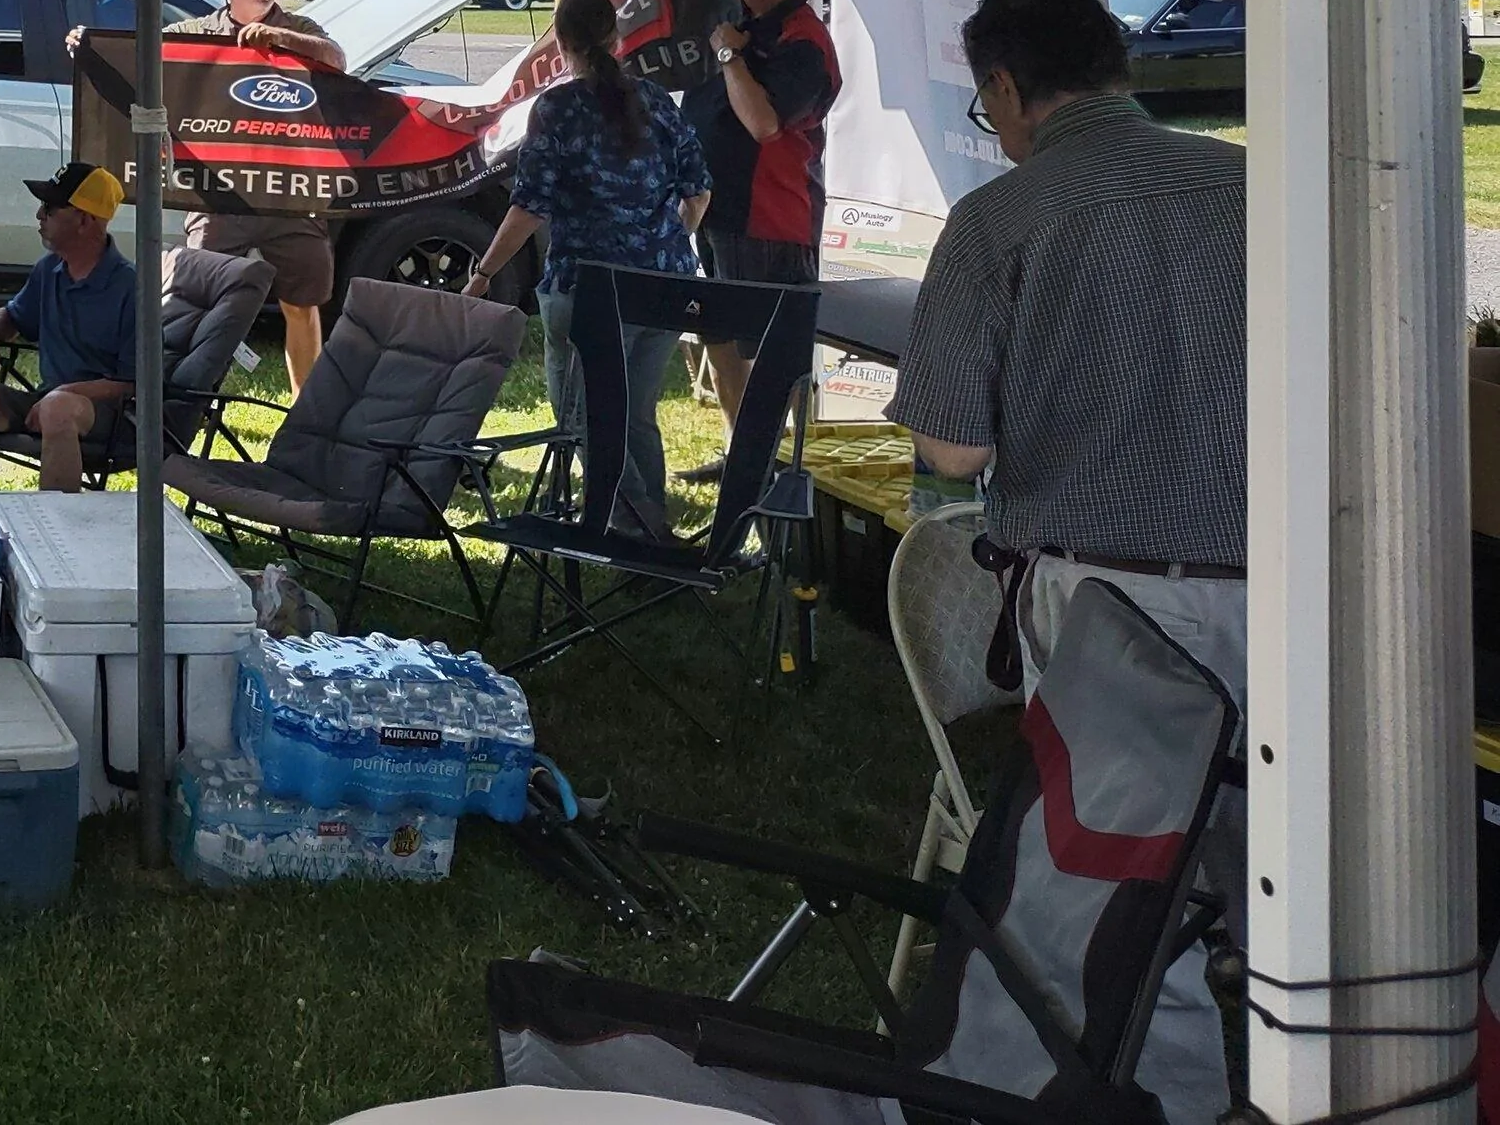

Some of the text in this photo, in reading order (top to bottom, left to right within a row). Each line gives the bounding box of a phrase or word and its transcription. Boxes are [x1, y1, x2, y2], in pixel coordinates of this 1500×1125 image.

[622, 40, 701, 75] LUB
[250, 79, 301, 105] Ford
[178, 118, 371, 140] FORD PERFORMANCE
[866, 219, 885, 228] Auto
[384, 728, 439, 741] KIRKLAND
[353, 757, 412, 774] purified
[415, 762, 462, 777] water
